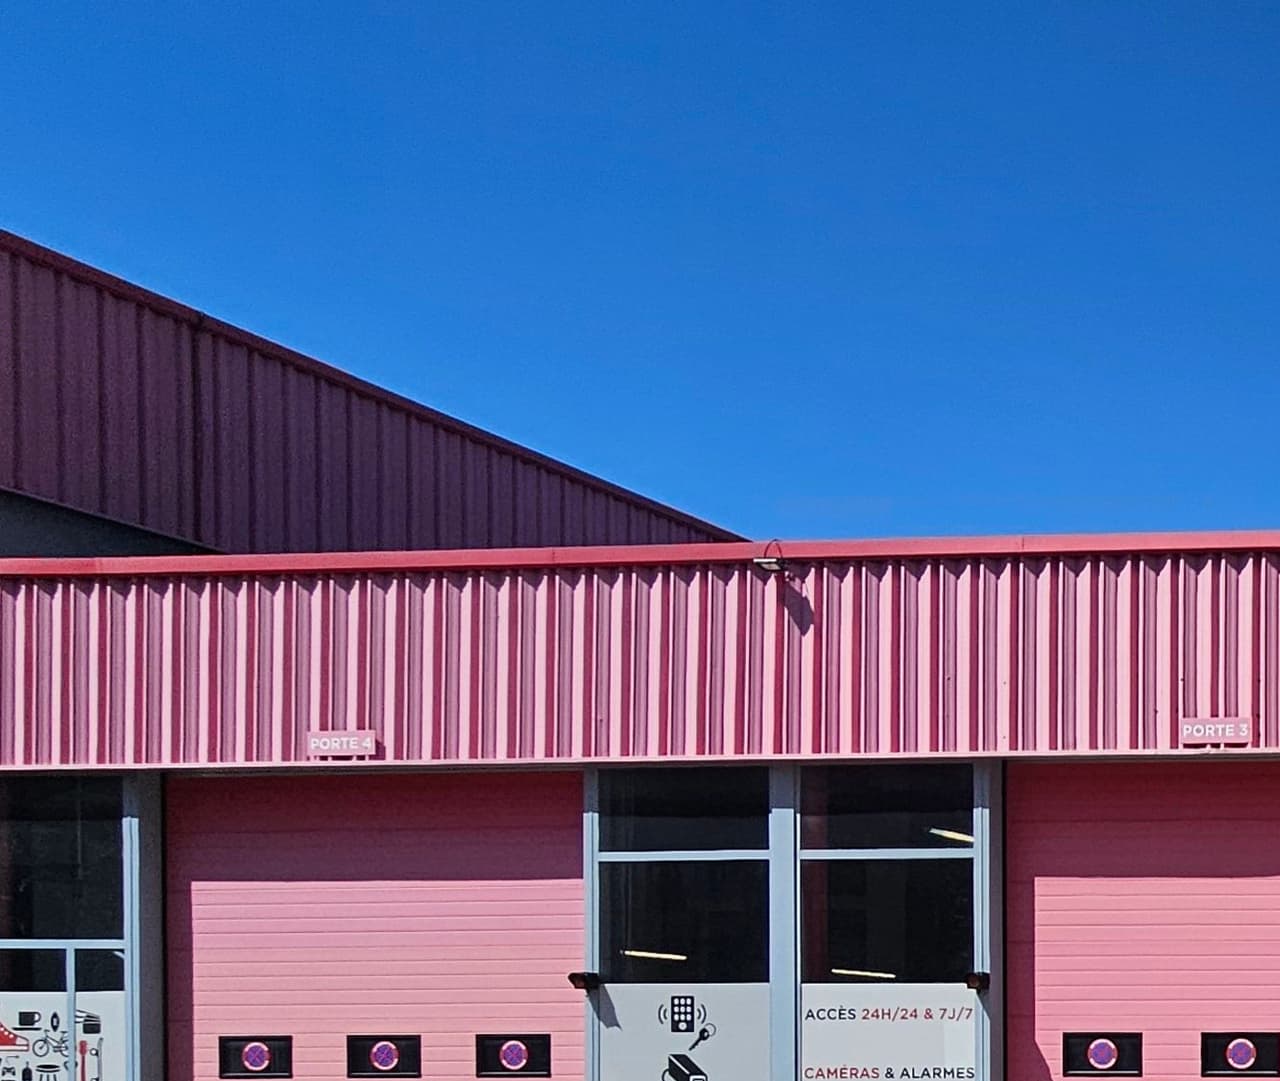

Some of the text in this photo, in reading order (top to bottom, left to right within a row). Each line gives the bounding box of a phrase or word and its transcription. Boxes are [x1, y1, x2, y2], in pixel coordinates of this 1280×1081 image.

[1183, 724, 1248, 737] PORTE 3
[311, 737, 372, 749] PORTE 4
[805, 1005, 974, 1022] ACCÈS 24H/24 & 7J/7
[804, 1064, 975, 1079] CAMÉRAS & ALARMES
